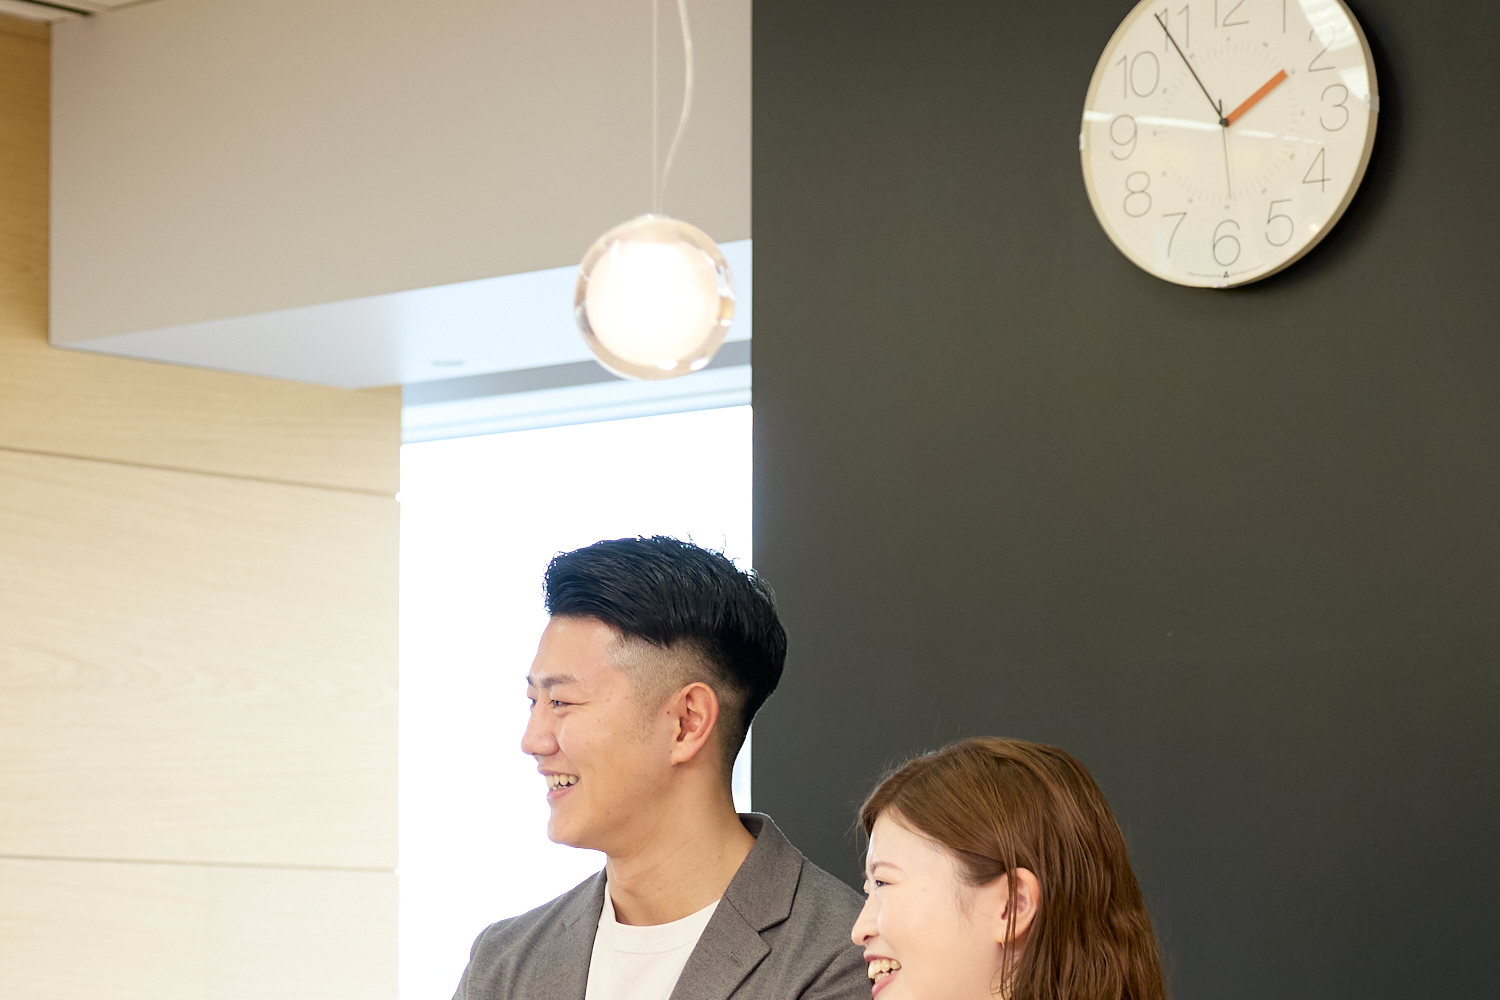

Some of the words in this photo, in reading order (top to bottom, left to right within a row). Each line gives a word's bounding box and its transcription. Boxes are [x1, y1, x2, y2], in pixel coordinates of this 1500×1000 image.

[1158, 4, 1189, 52] 11
[1308, 24, 1336, 73] 2
[1115, 50, 1160, 99] 10
[1320, 83, 1349, 132] 3
[1110, 114, 1138, 161] 9
[1302, 147, 1331, 192] 4
[1123, 170, 1152, 218] 8
[1162, 211, 1187, 258] 7
[1212, 219, 1241, 267] 6
[1266, 199, 1294, 247] 5
